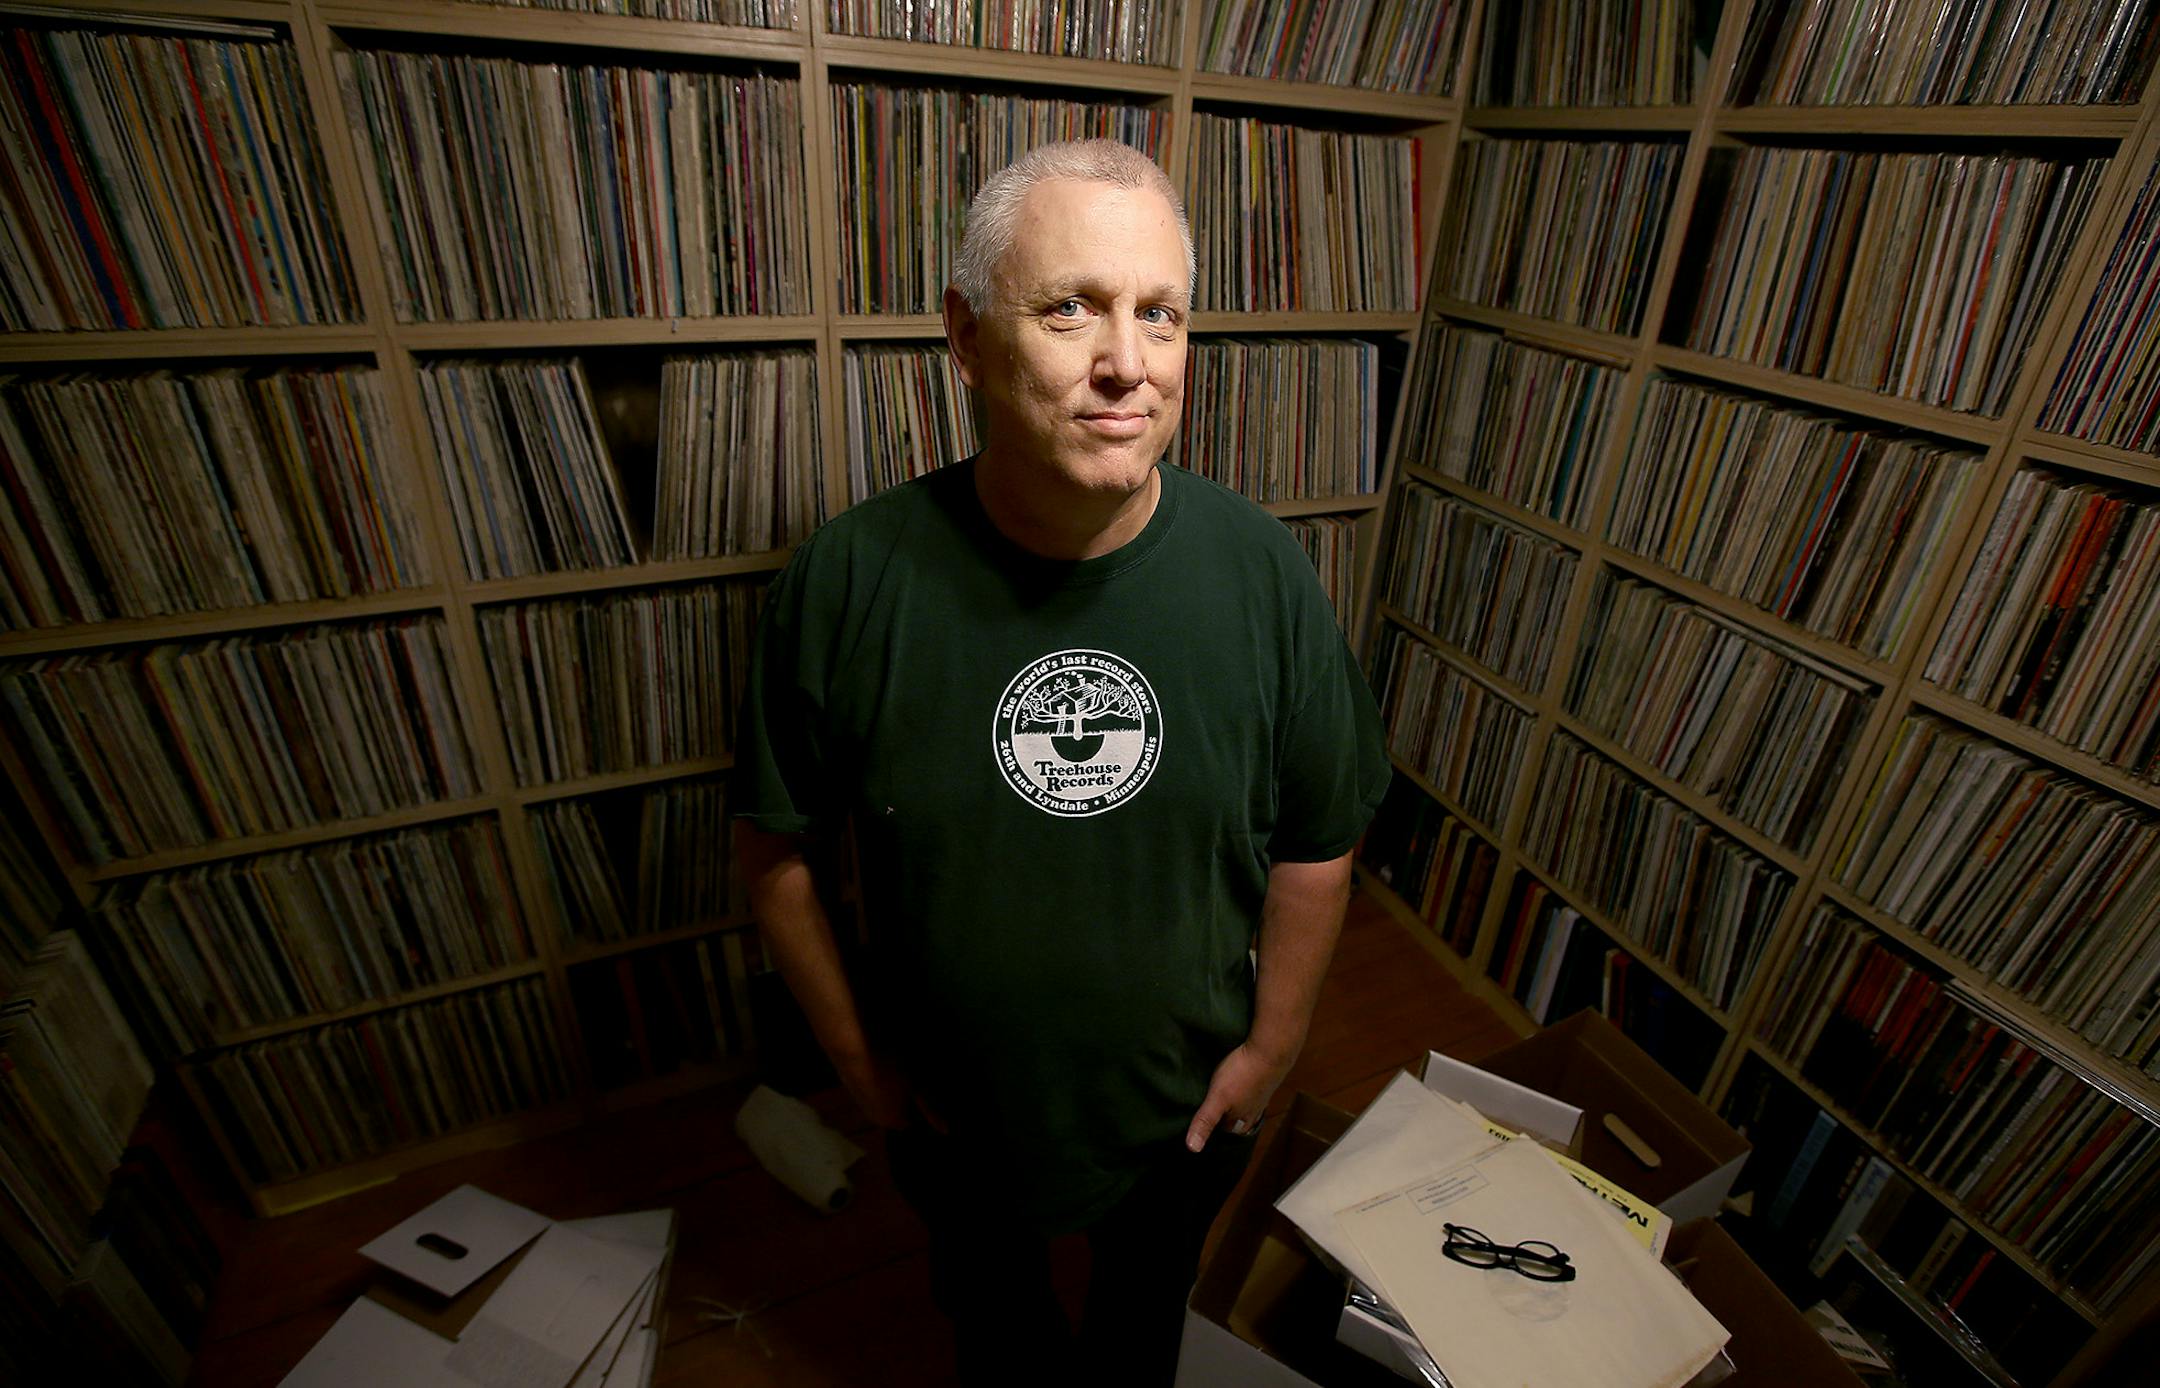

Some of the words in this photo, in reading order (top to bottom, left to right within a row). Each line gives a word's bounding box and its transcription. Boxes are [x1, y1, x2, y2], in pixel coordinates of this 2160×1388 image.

[1002, 696, 1018, 719] the
[1013, 659, 1059, 695] world's
[1061, 655, 1088, 666] last
[1090, 657, 1134, 681] record
[1131, 680, 1153, 714] store
[1000, 740, 1016, 772] 26th
[1013, 769, 1035, 794] and
[1034, 790, 1089, 812] Lyndale
[1103, 736, 1158, 804] Minneapolis
[1034, 760, 1122, 776] Treehouse
[1046, 774, 1115, 792] Records
